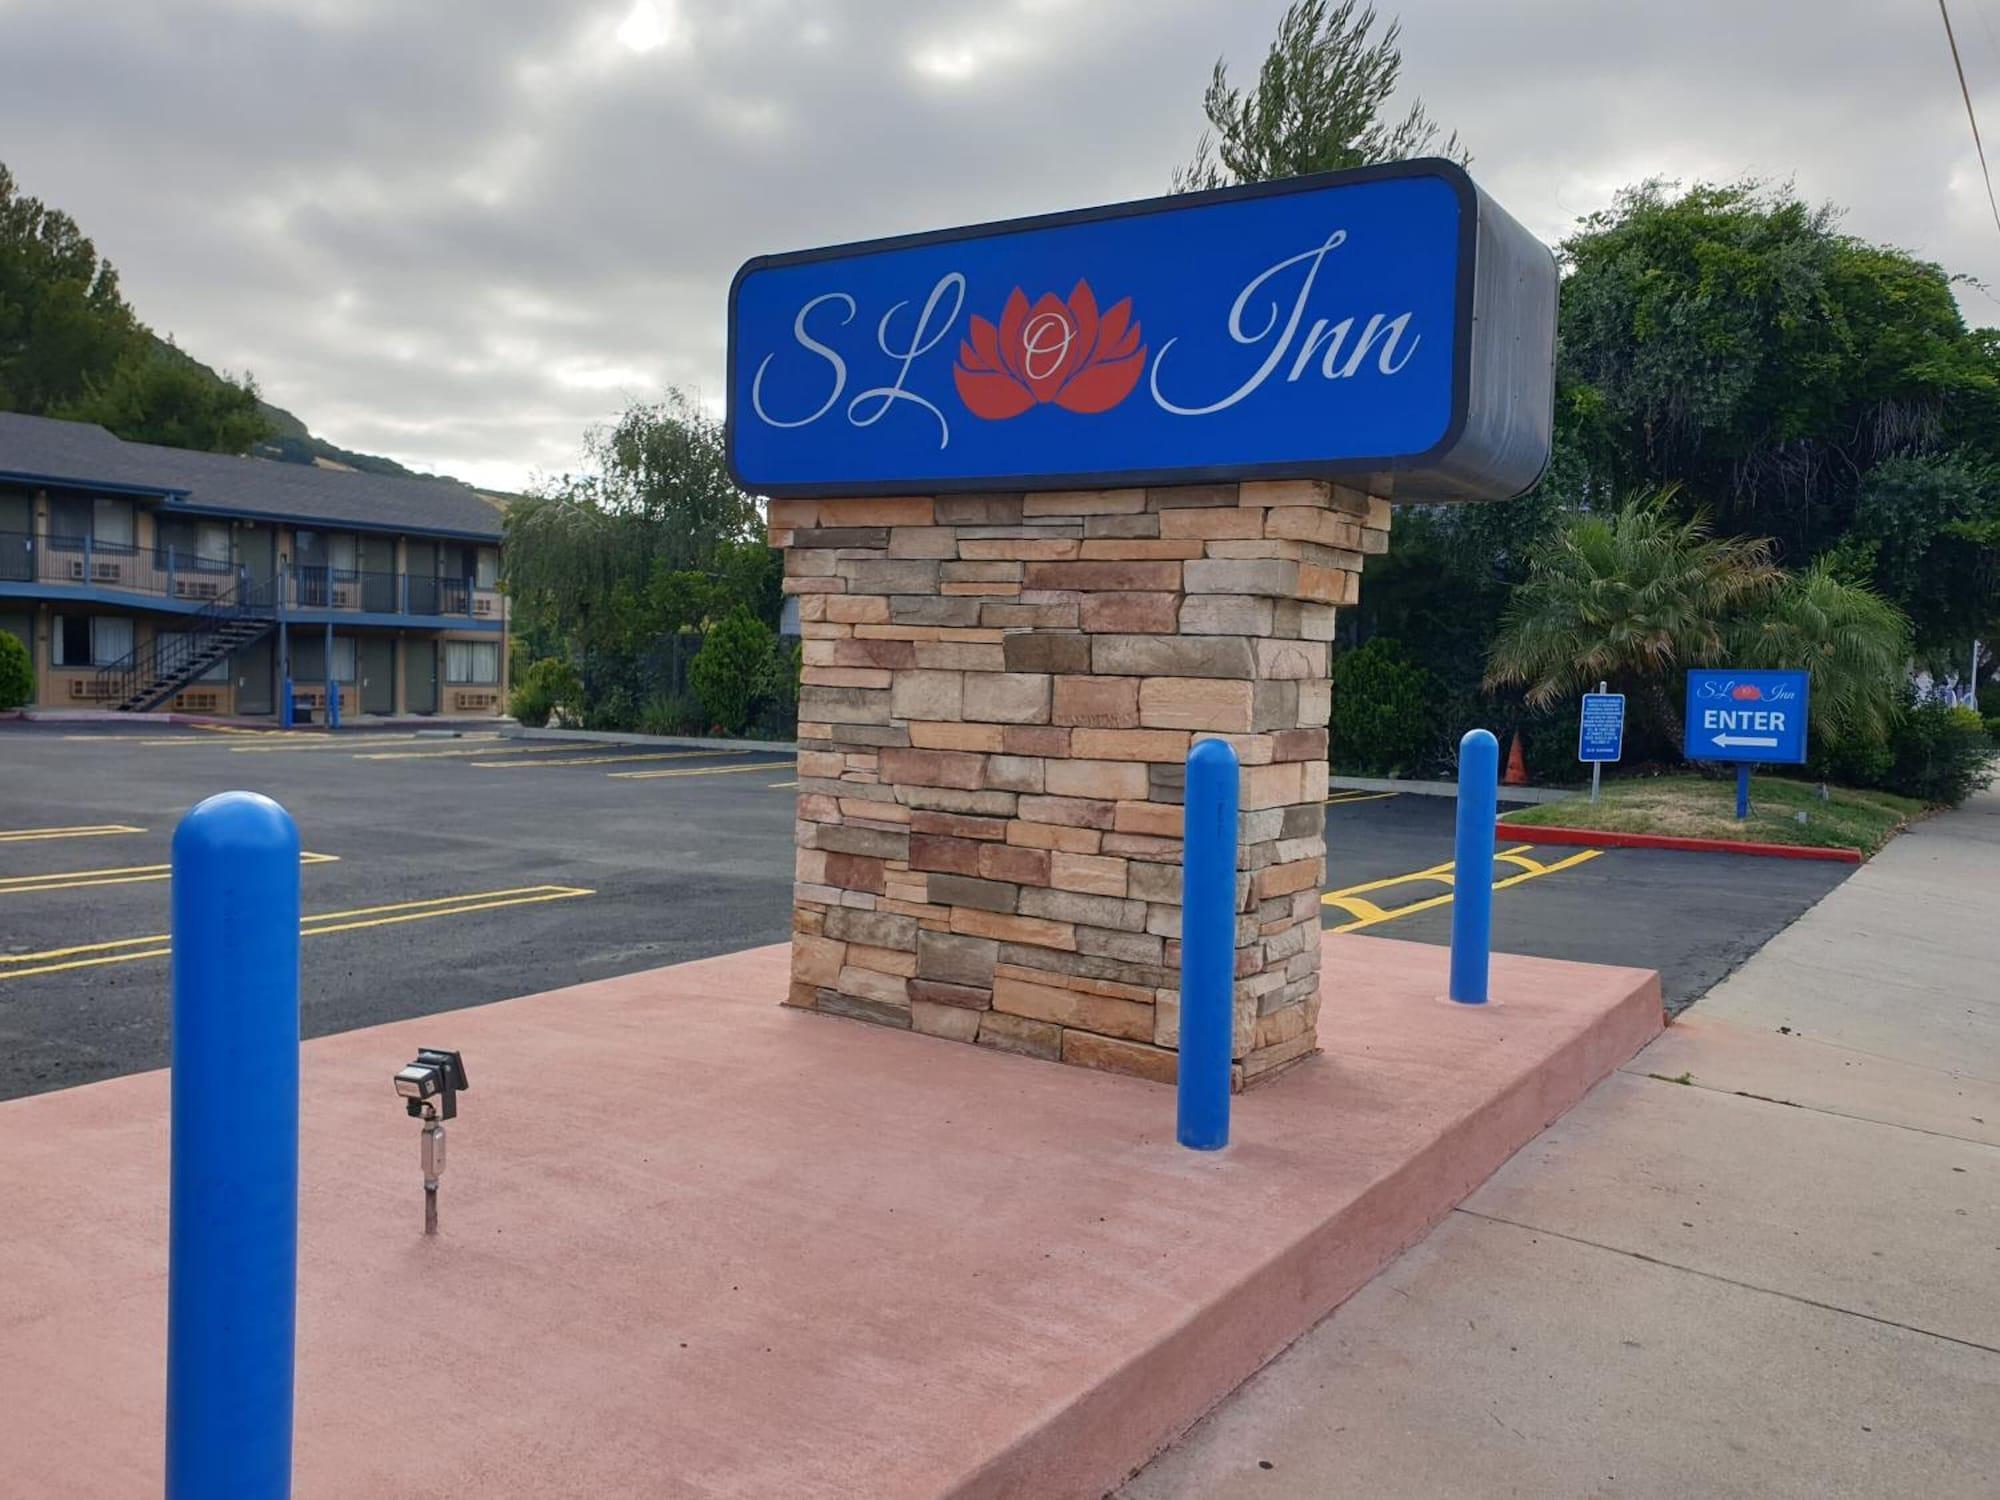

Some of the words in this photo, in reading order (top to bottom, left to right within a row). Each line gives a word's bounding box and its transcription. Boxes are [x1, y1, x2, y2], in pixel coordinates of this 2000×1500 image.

[1150, 229, 1421, 416] Inn
[1760, 682, 1796, 702] Inn
[1703, 709, 1786, 732] ENTER
